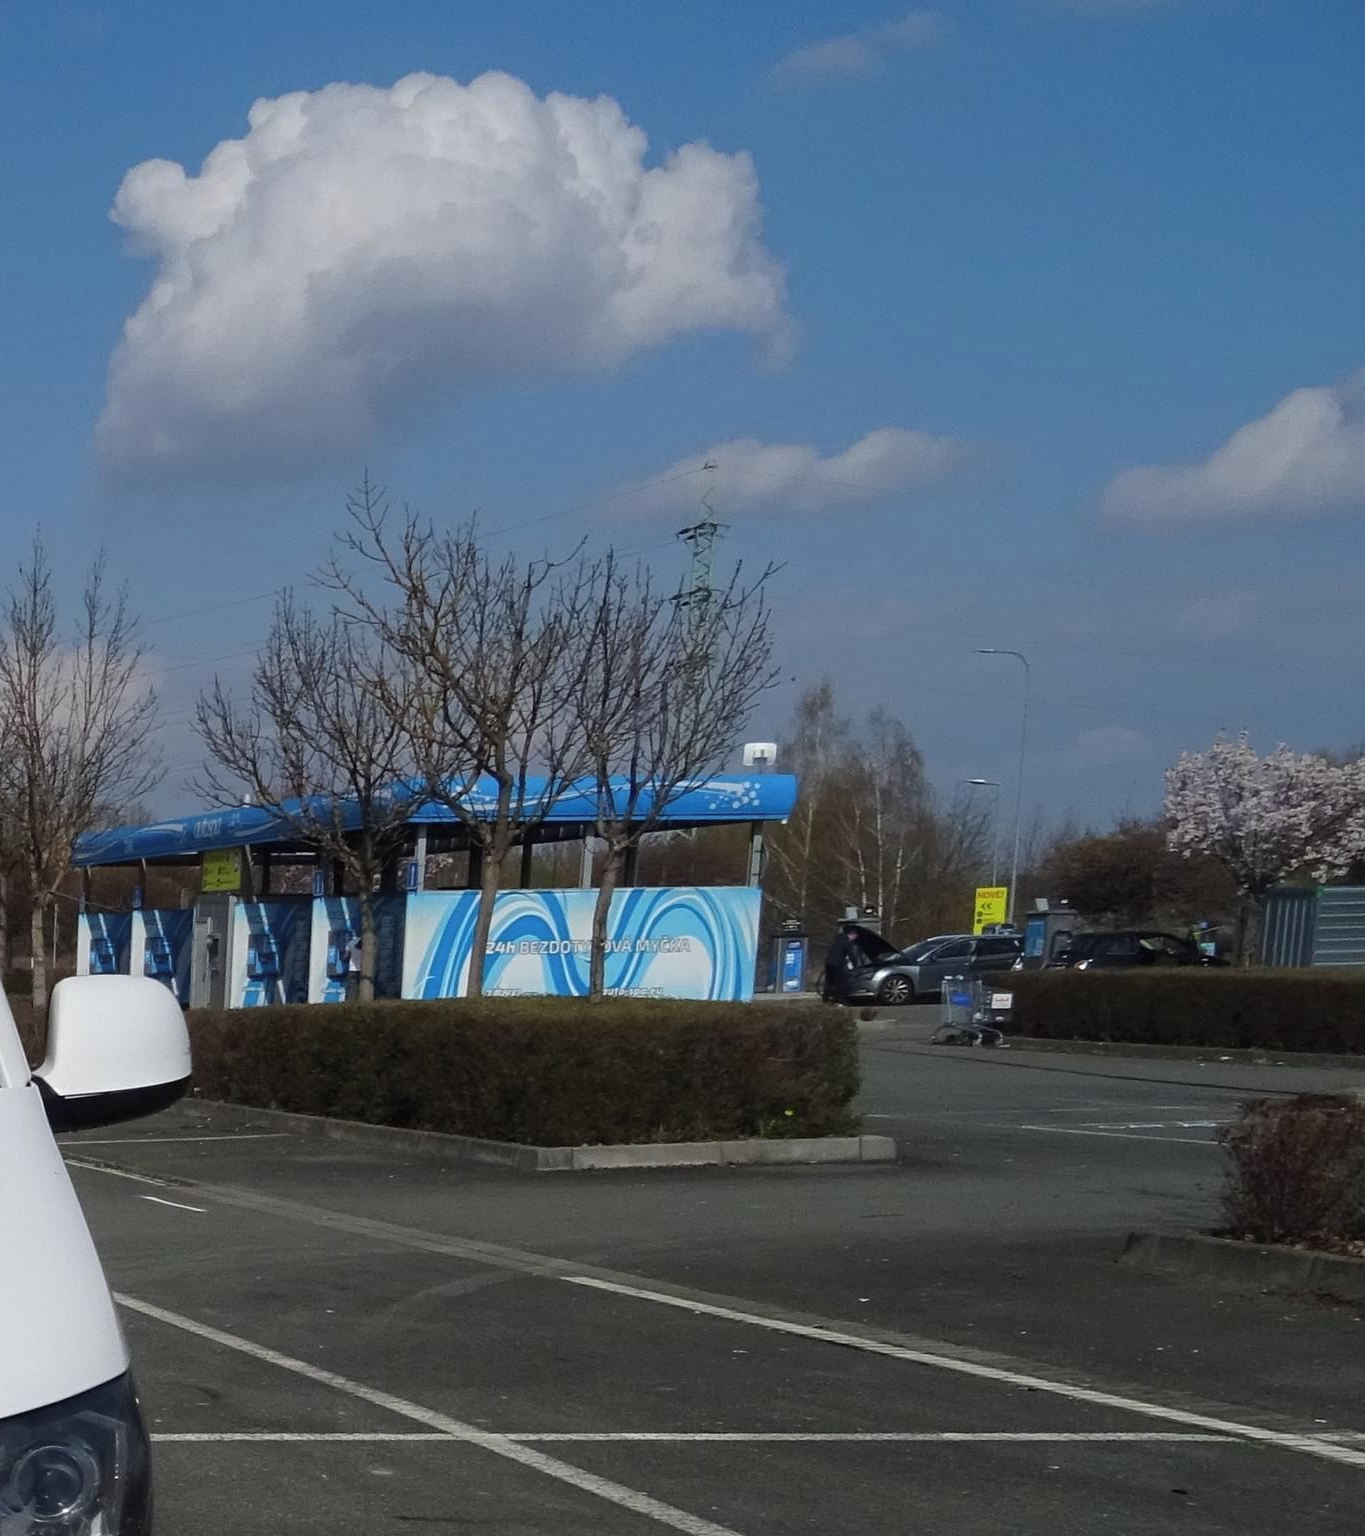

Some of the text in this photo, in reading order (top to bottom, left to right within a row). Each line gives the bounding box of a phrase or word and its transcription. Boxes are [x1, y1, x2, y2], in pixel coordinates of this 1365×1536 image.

[485, 935, 691, 955] 24h BEZDOTYOVÁ MYČKA
